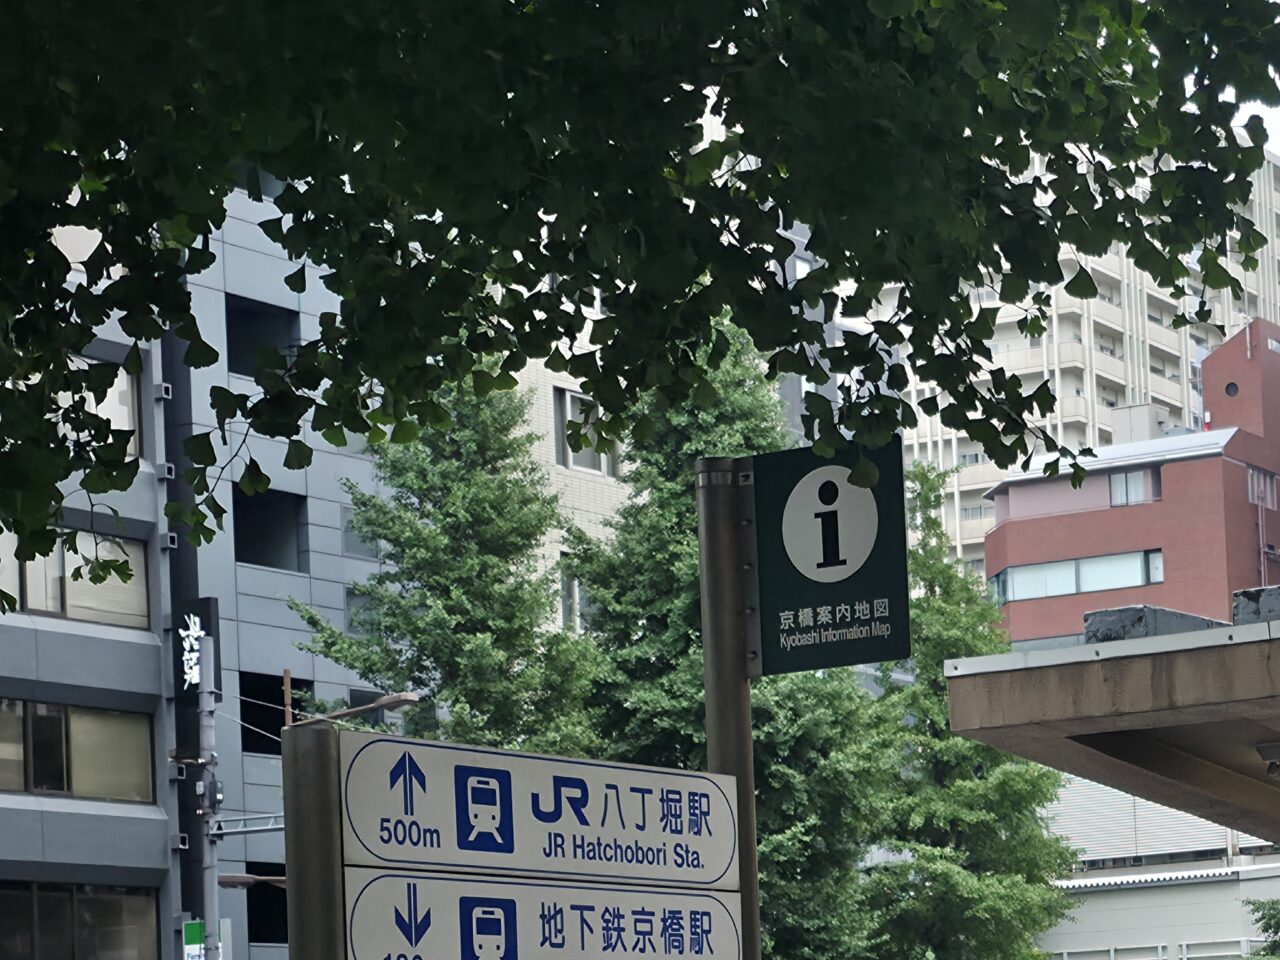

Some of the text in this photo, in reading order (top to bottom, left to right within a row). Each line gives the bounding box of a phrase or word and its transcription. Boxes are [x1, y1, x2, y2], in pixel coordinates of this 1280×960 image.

[779, 598, 889, 630] 京橋案内地図
[780, 620, 891, 651] Kyobashi Information Map
[379, 817, 441, 849] 500m
[542, 832, 705, 870] JR Hatchobori Sta.
[539, 901, 714, 957] 地下鉄京橋駅
